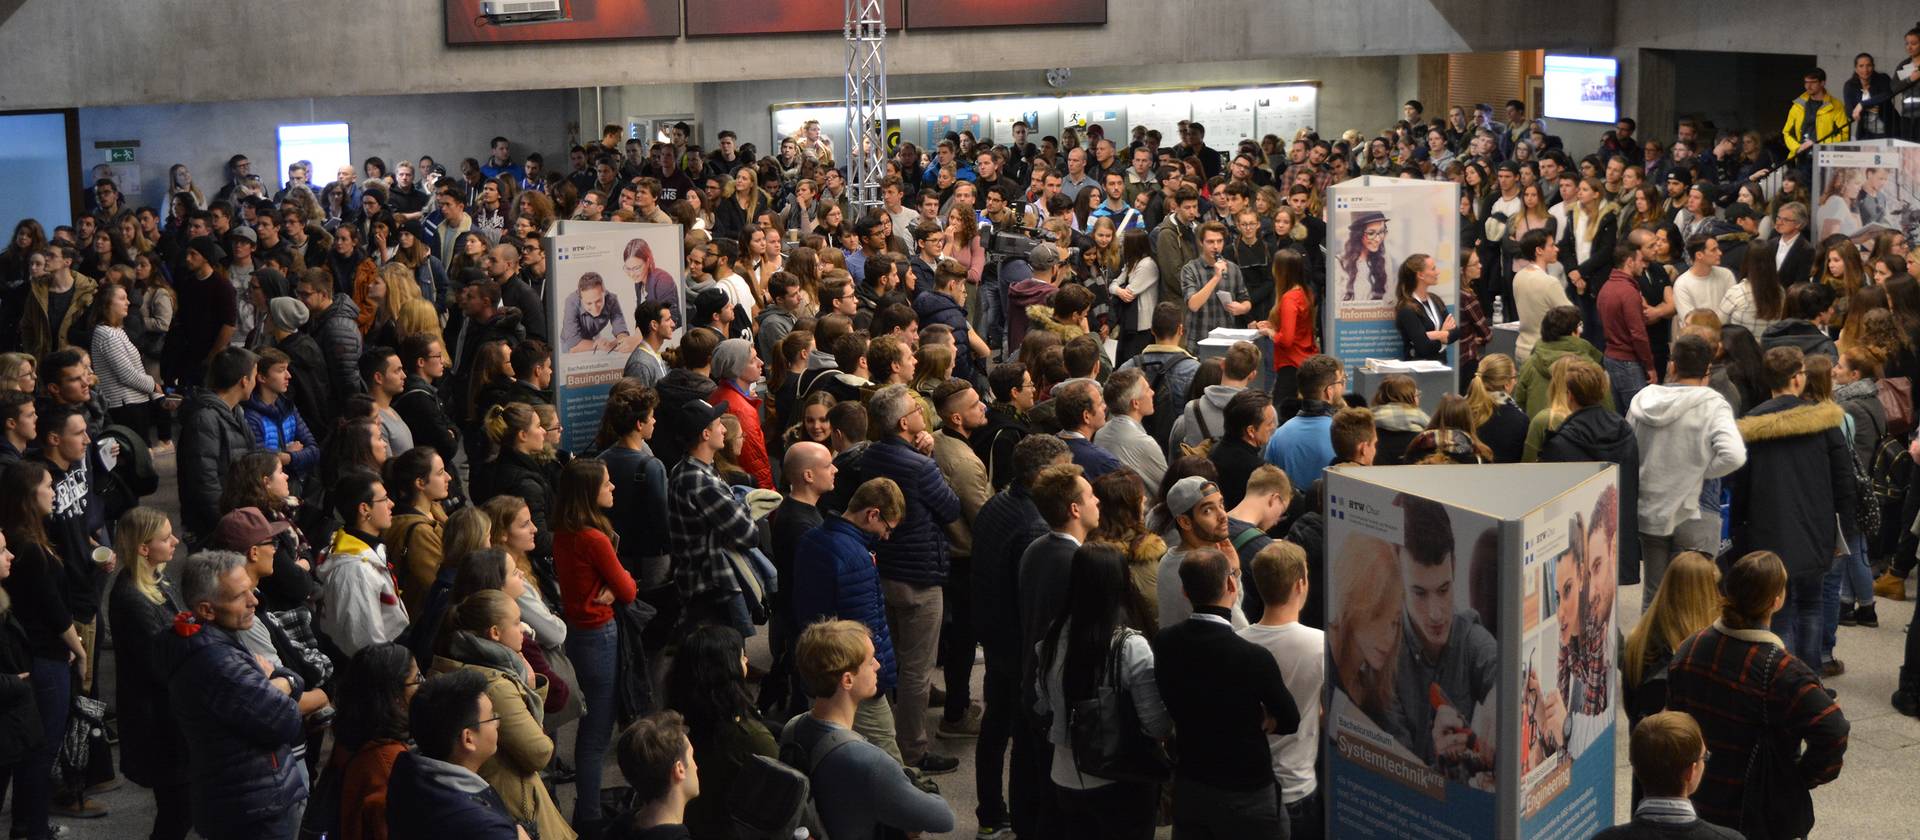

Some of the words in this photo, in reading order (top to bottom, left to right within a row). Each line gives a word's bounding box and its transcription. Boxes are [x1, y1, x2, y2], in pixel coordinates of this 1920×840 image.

[1342, 310, 1395, 319] Information
[1348, 499, 1365, 512] HTW
[1338, 715, 1393, 746] Bachelorstudium
[1526, 767, 1571, 814] Engineering
